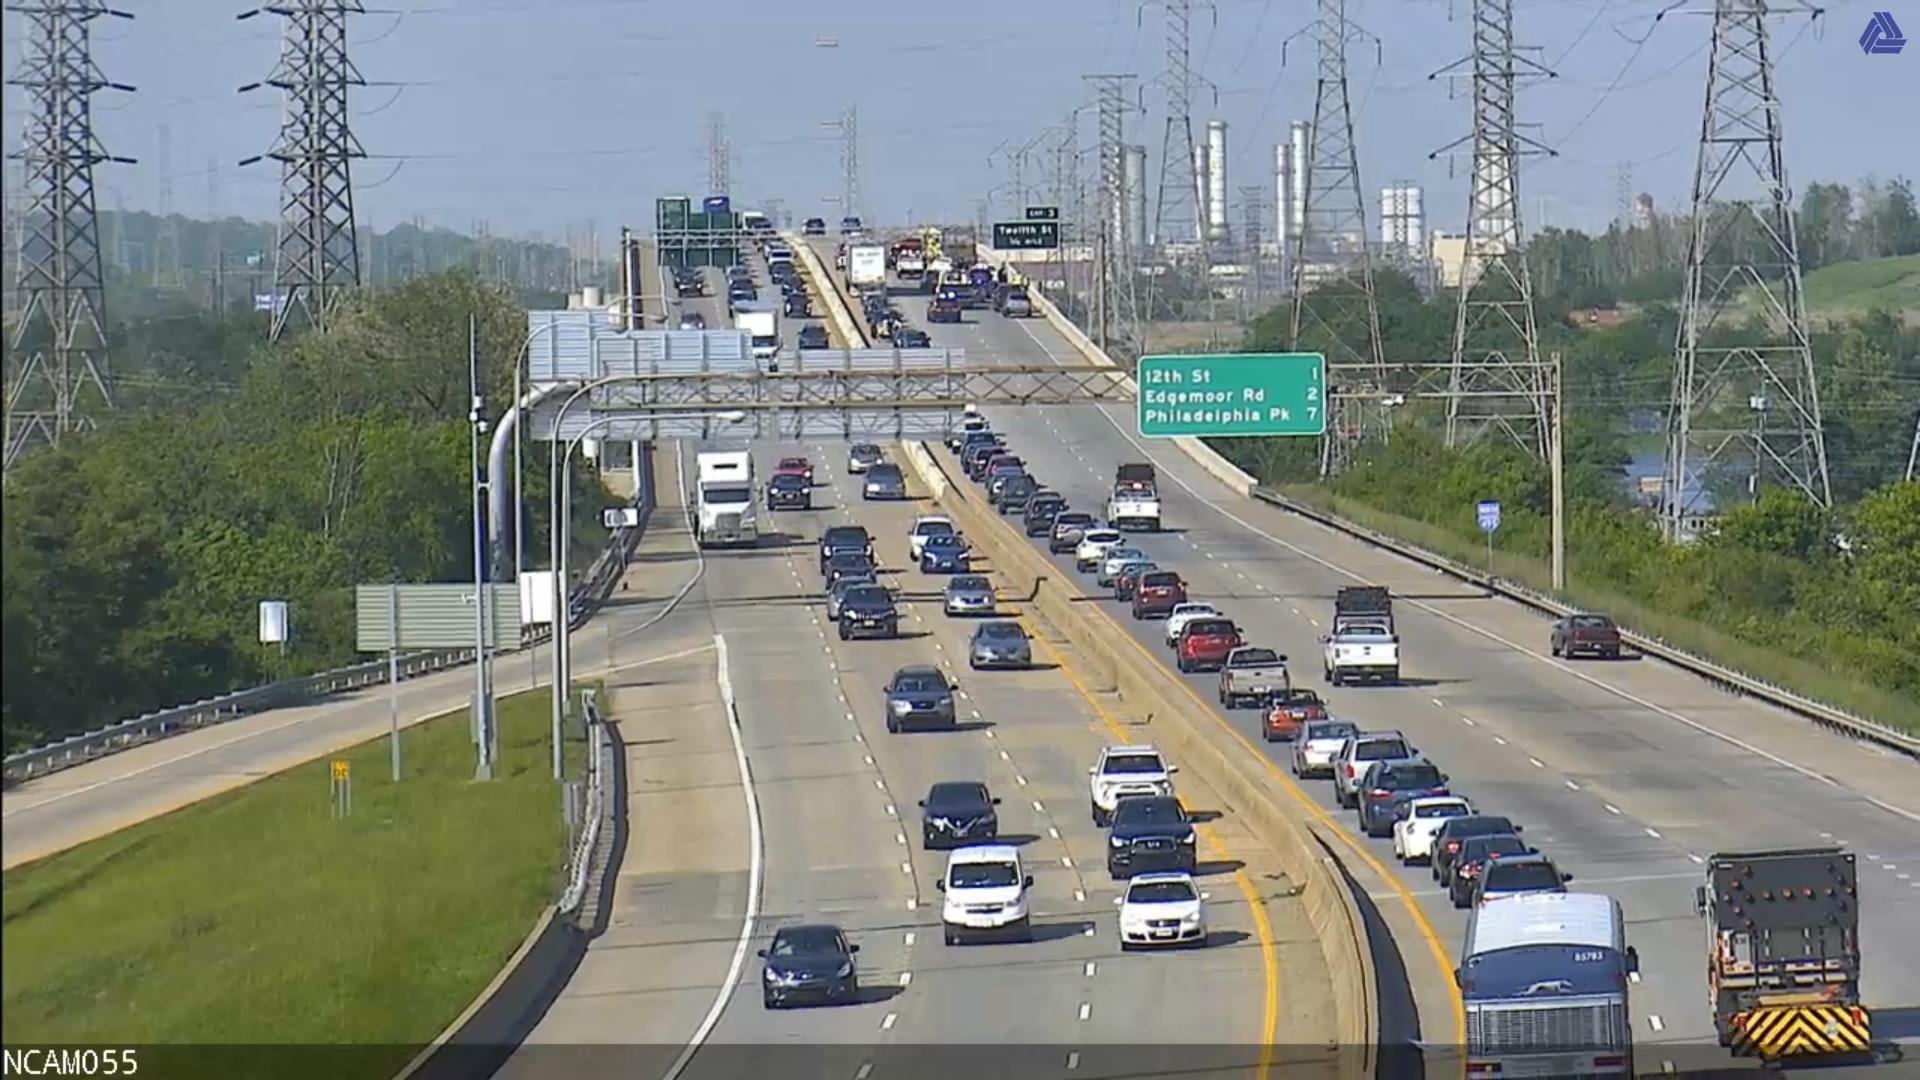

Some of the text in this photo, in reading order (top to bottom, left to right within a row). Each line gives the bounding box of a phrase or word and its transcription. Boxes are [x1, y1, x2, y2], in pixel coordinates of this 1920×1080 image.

[1145, 367, 1318, 383] 12th St 1
[1145, 387, 1318, 406] Edgemoor Rd 2
[1145, 408, 1318, 424] Philadelphia Pk 7
